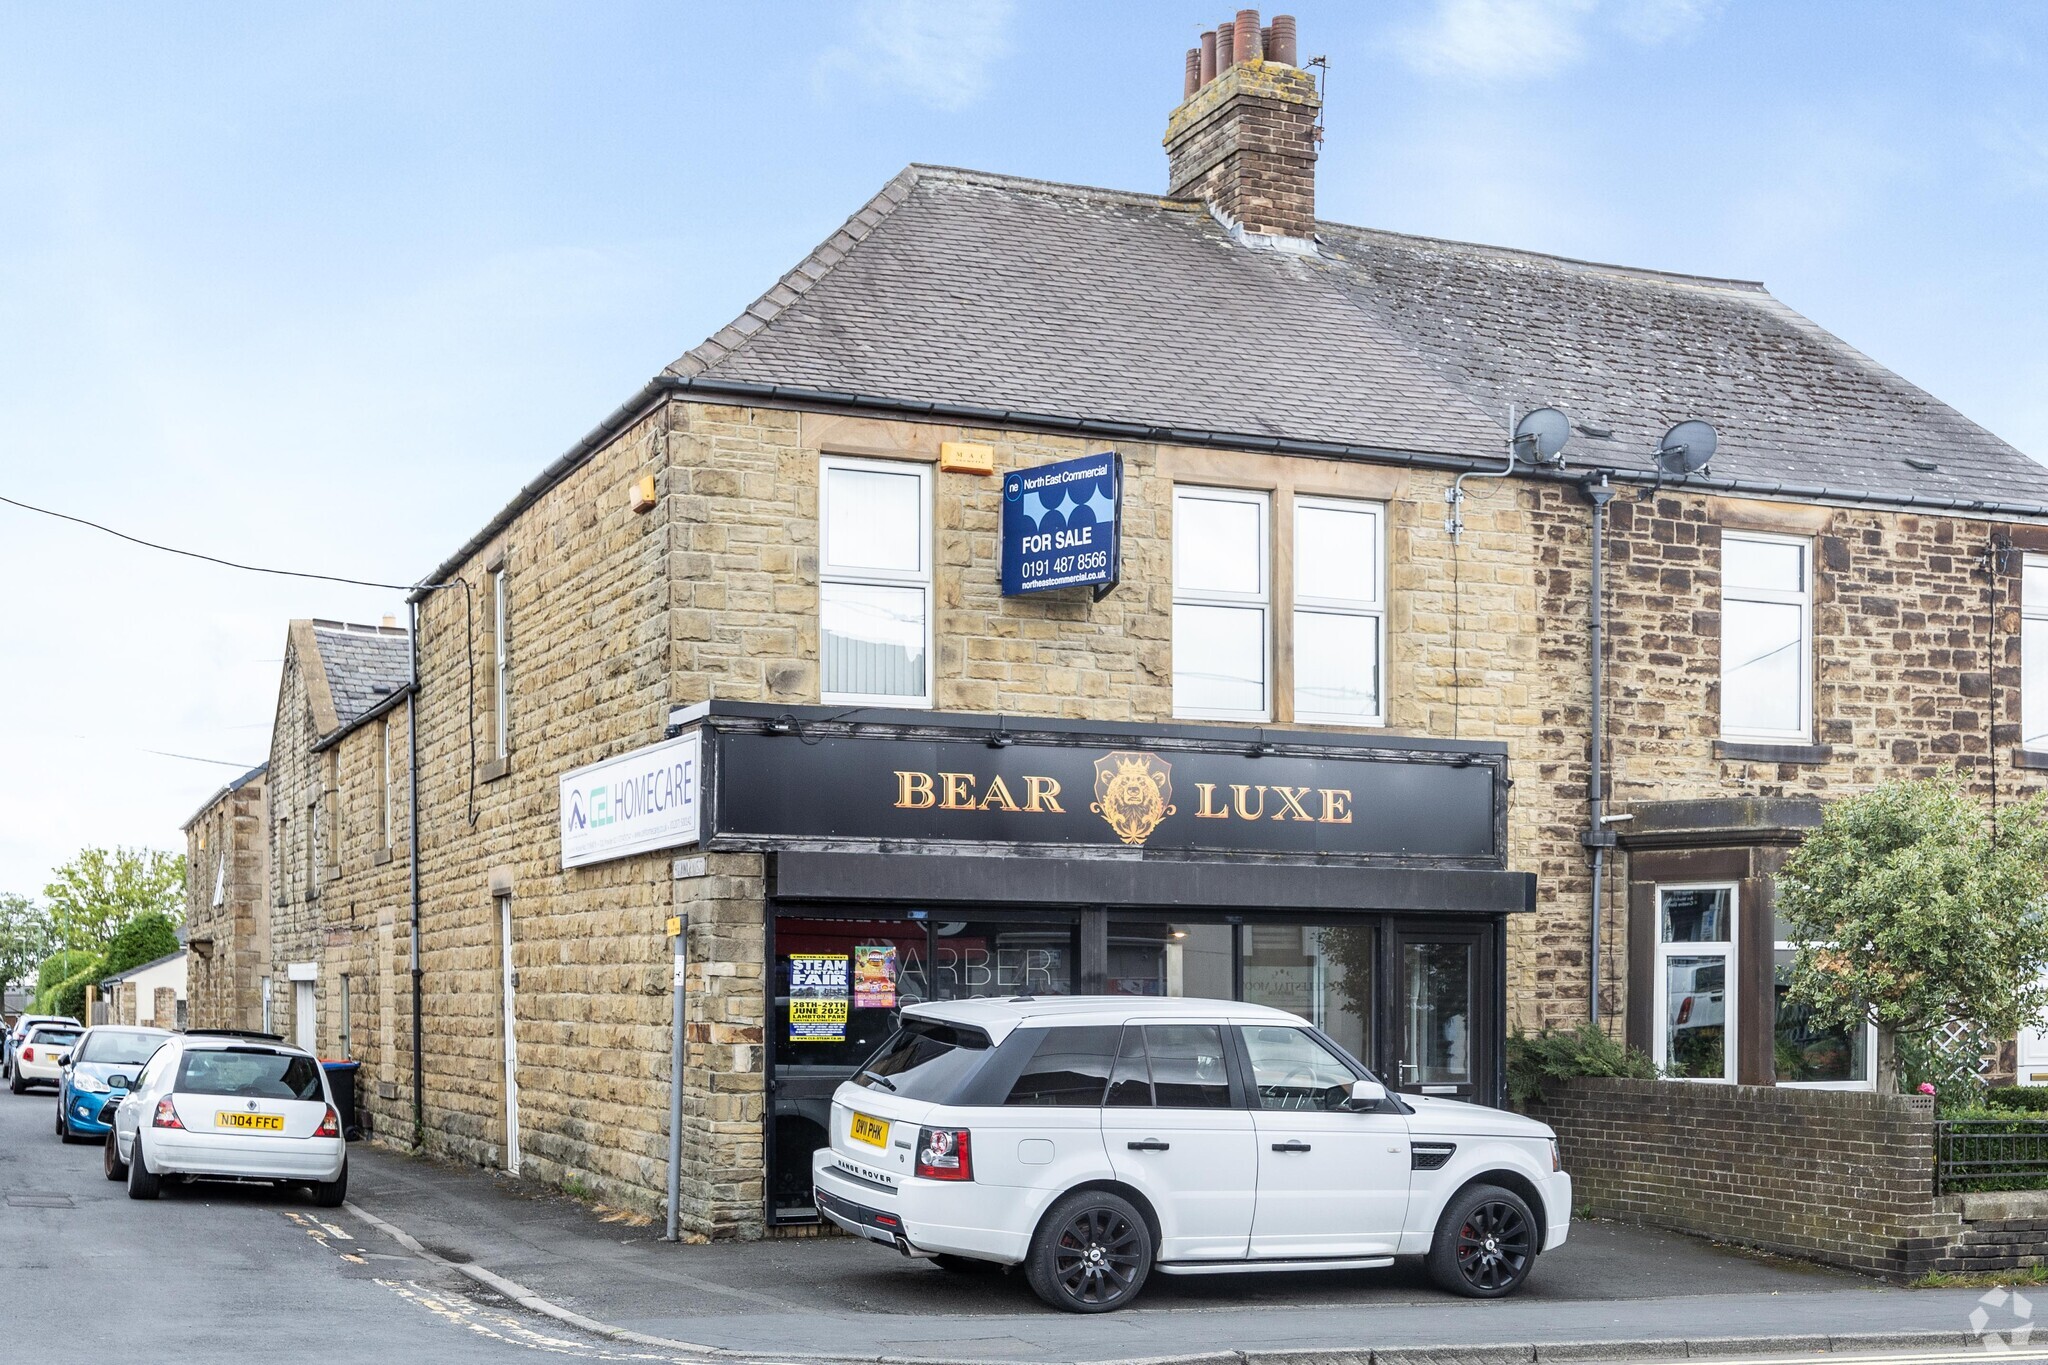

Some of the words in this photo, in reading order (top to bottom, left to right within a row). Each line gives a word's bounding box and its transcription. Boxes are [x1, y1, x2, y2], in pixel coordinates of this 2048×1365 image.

[1009, 483, 1019, 493] ne
[1024, 477, 1044, 490] North
[1045, 473, 1062, 486] East
[1062, 464, 1108, 483] Commercial
[1022, 533, 1052, 555] FOR
[1055, 526, 1092, 549] SALE
[1022, 559, 1049, 578] 0191
[1053, 555, 1075, 573] 487
[1077, 551, 1107, 570] 8566
[1022, 569, 1107, 590] northeastcommercial.co.uk
[614, 760, 692, 823] HOMECARE
[893, 770, 1067, 813] BEAR
[1194, 782, 1353, 824] LUXE
[793, 960, 846, 970] STEAM
[793, 974, 846, 984] FAIR
[222, 1113, 252, 1127] ND04
[255, 1117, 279, 1129] FFC
[867, 1122, 883, 1140] PHK
[838, 1160, 859, 1173] RANGE
[862, 1169, 892, 1183] ROVER
